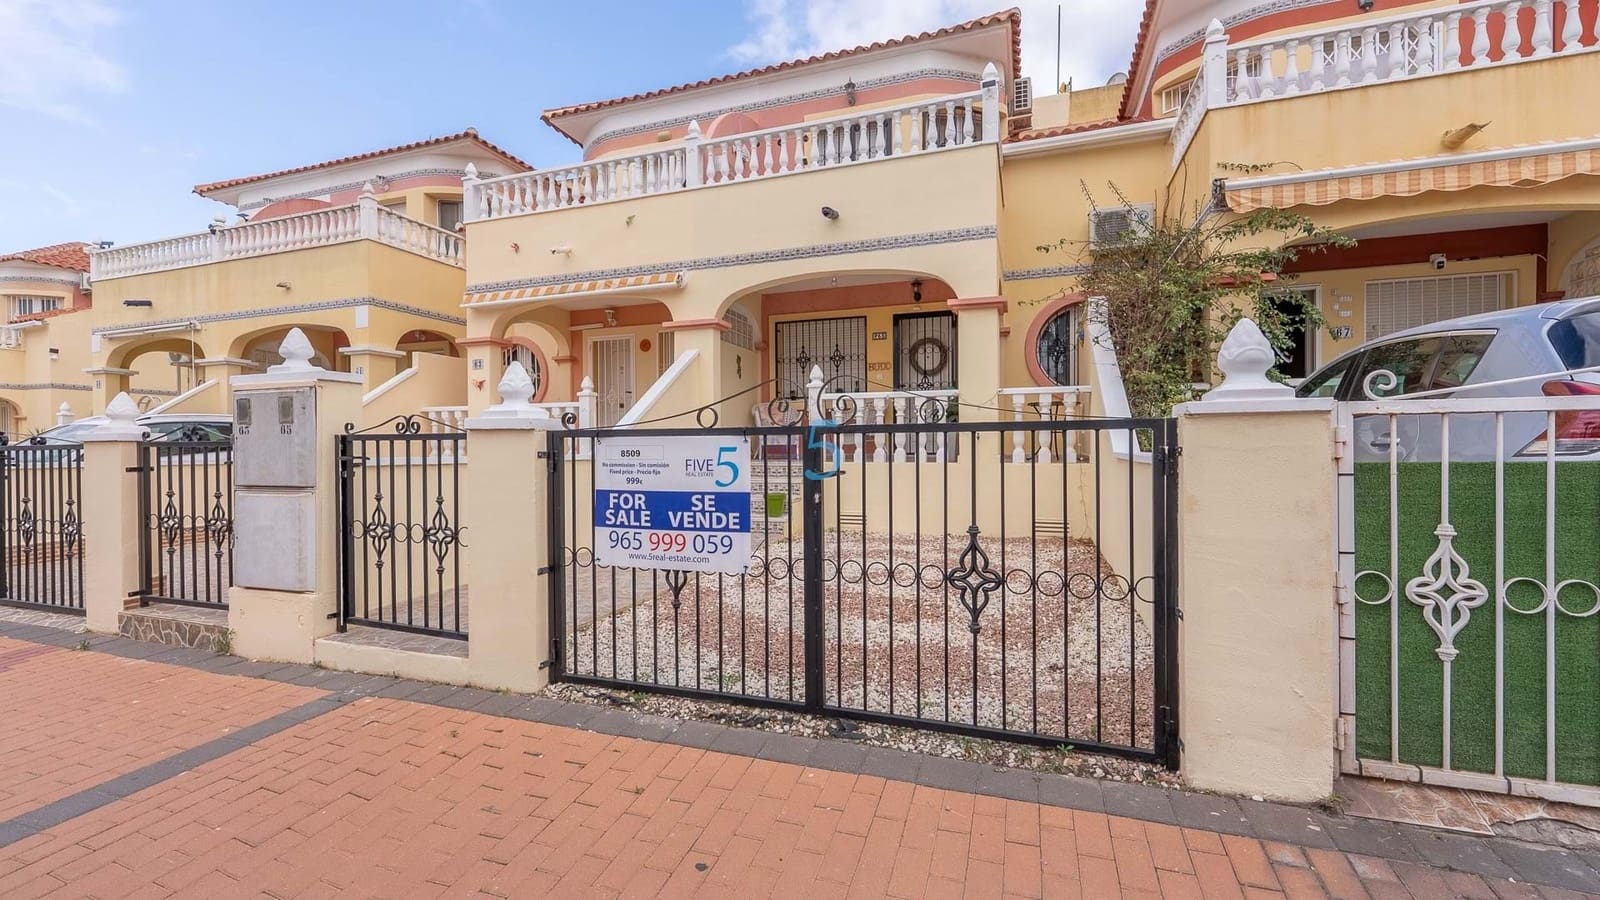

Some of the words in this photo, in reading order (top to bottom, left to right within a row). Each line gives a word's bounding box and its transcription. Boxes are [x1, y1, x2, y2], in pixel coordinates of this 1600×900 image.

[239, 426, 250, 435] 65
[280, 424, 292, 435] 65
[620, 449, 641, 458] 8509
[685, 458, 714, 472] FIVE
[715, 446, 739, 488] 5
[609, 493, 646, 510] FOR
[691, 494, 716, 511] SE
[605, 509, 651, 526] SALE
[668, 511, 740, 529] VENDE
[609, 530, 642, 550] 965
[649, 532, 686, 553] 999
[693, 534, 733, 554] 059
[628, 551, 710, 564] www.5real-estate.com
